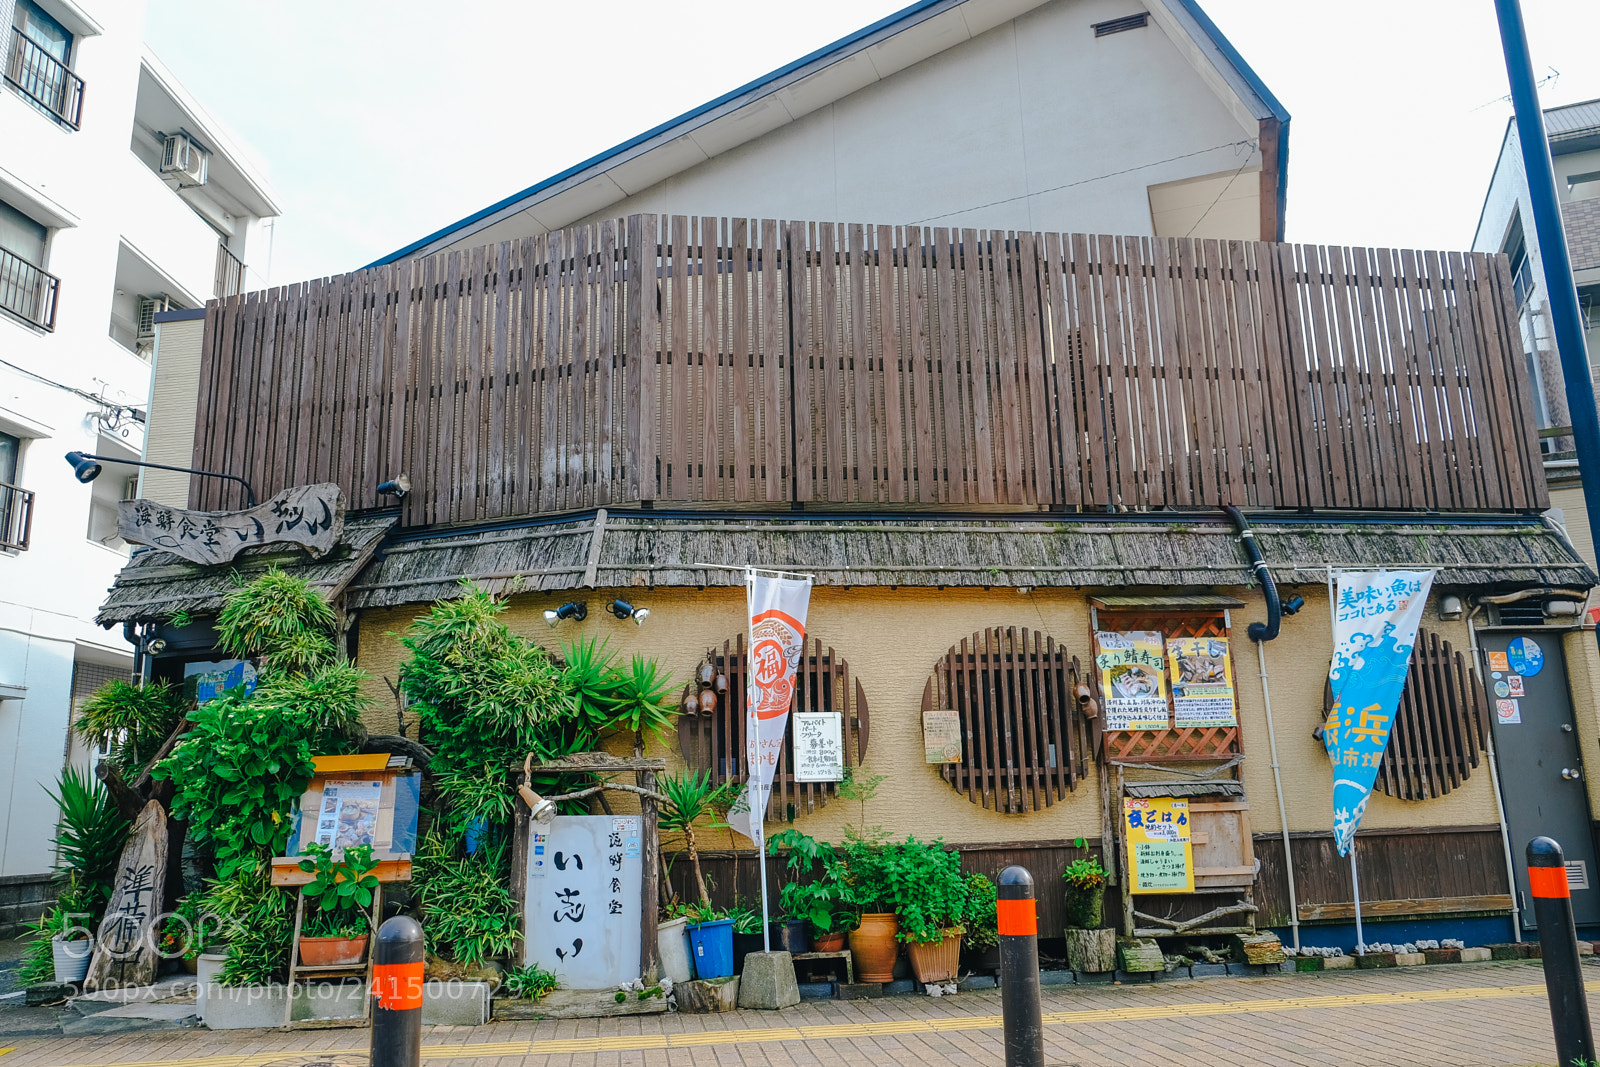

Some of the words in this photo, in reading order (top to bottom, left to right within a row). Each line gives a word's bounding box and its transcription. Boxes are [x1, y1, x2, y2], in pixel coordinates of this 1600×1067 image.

[134, 504, 221, 547] 海鮮食堂
[1338, 578, 1422, 610] 美味い魚は
[1338, 599, 1397, 622] ココにある
[755, 645, 779, 681] 福
[1101, 648, 1164, 670] 炙り鯖寿司
[1127, 810, 1187, 828] 夜ごはん
[608, 832, 623, 915] 海鮮食堂
[103, 864, 155, 982] 準備中
